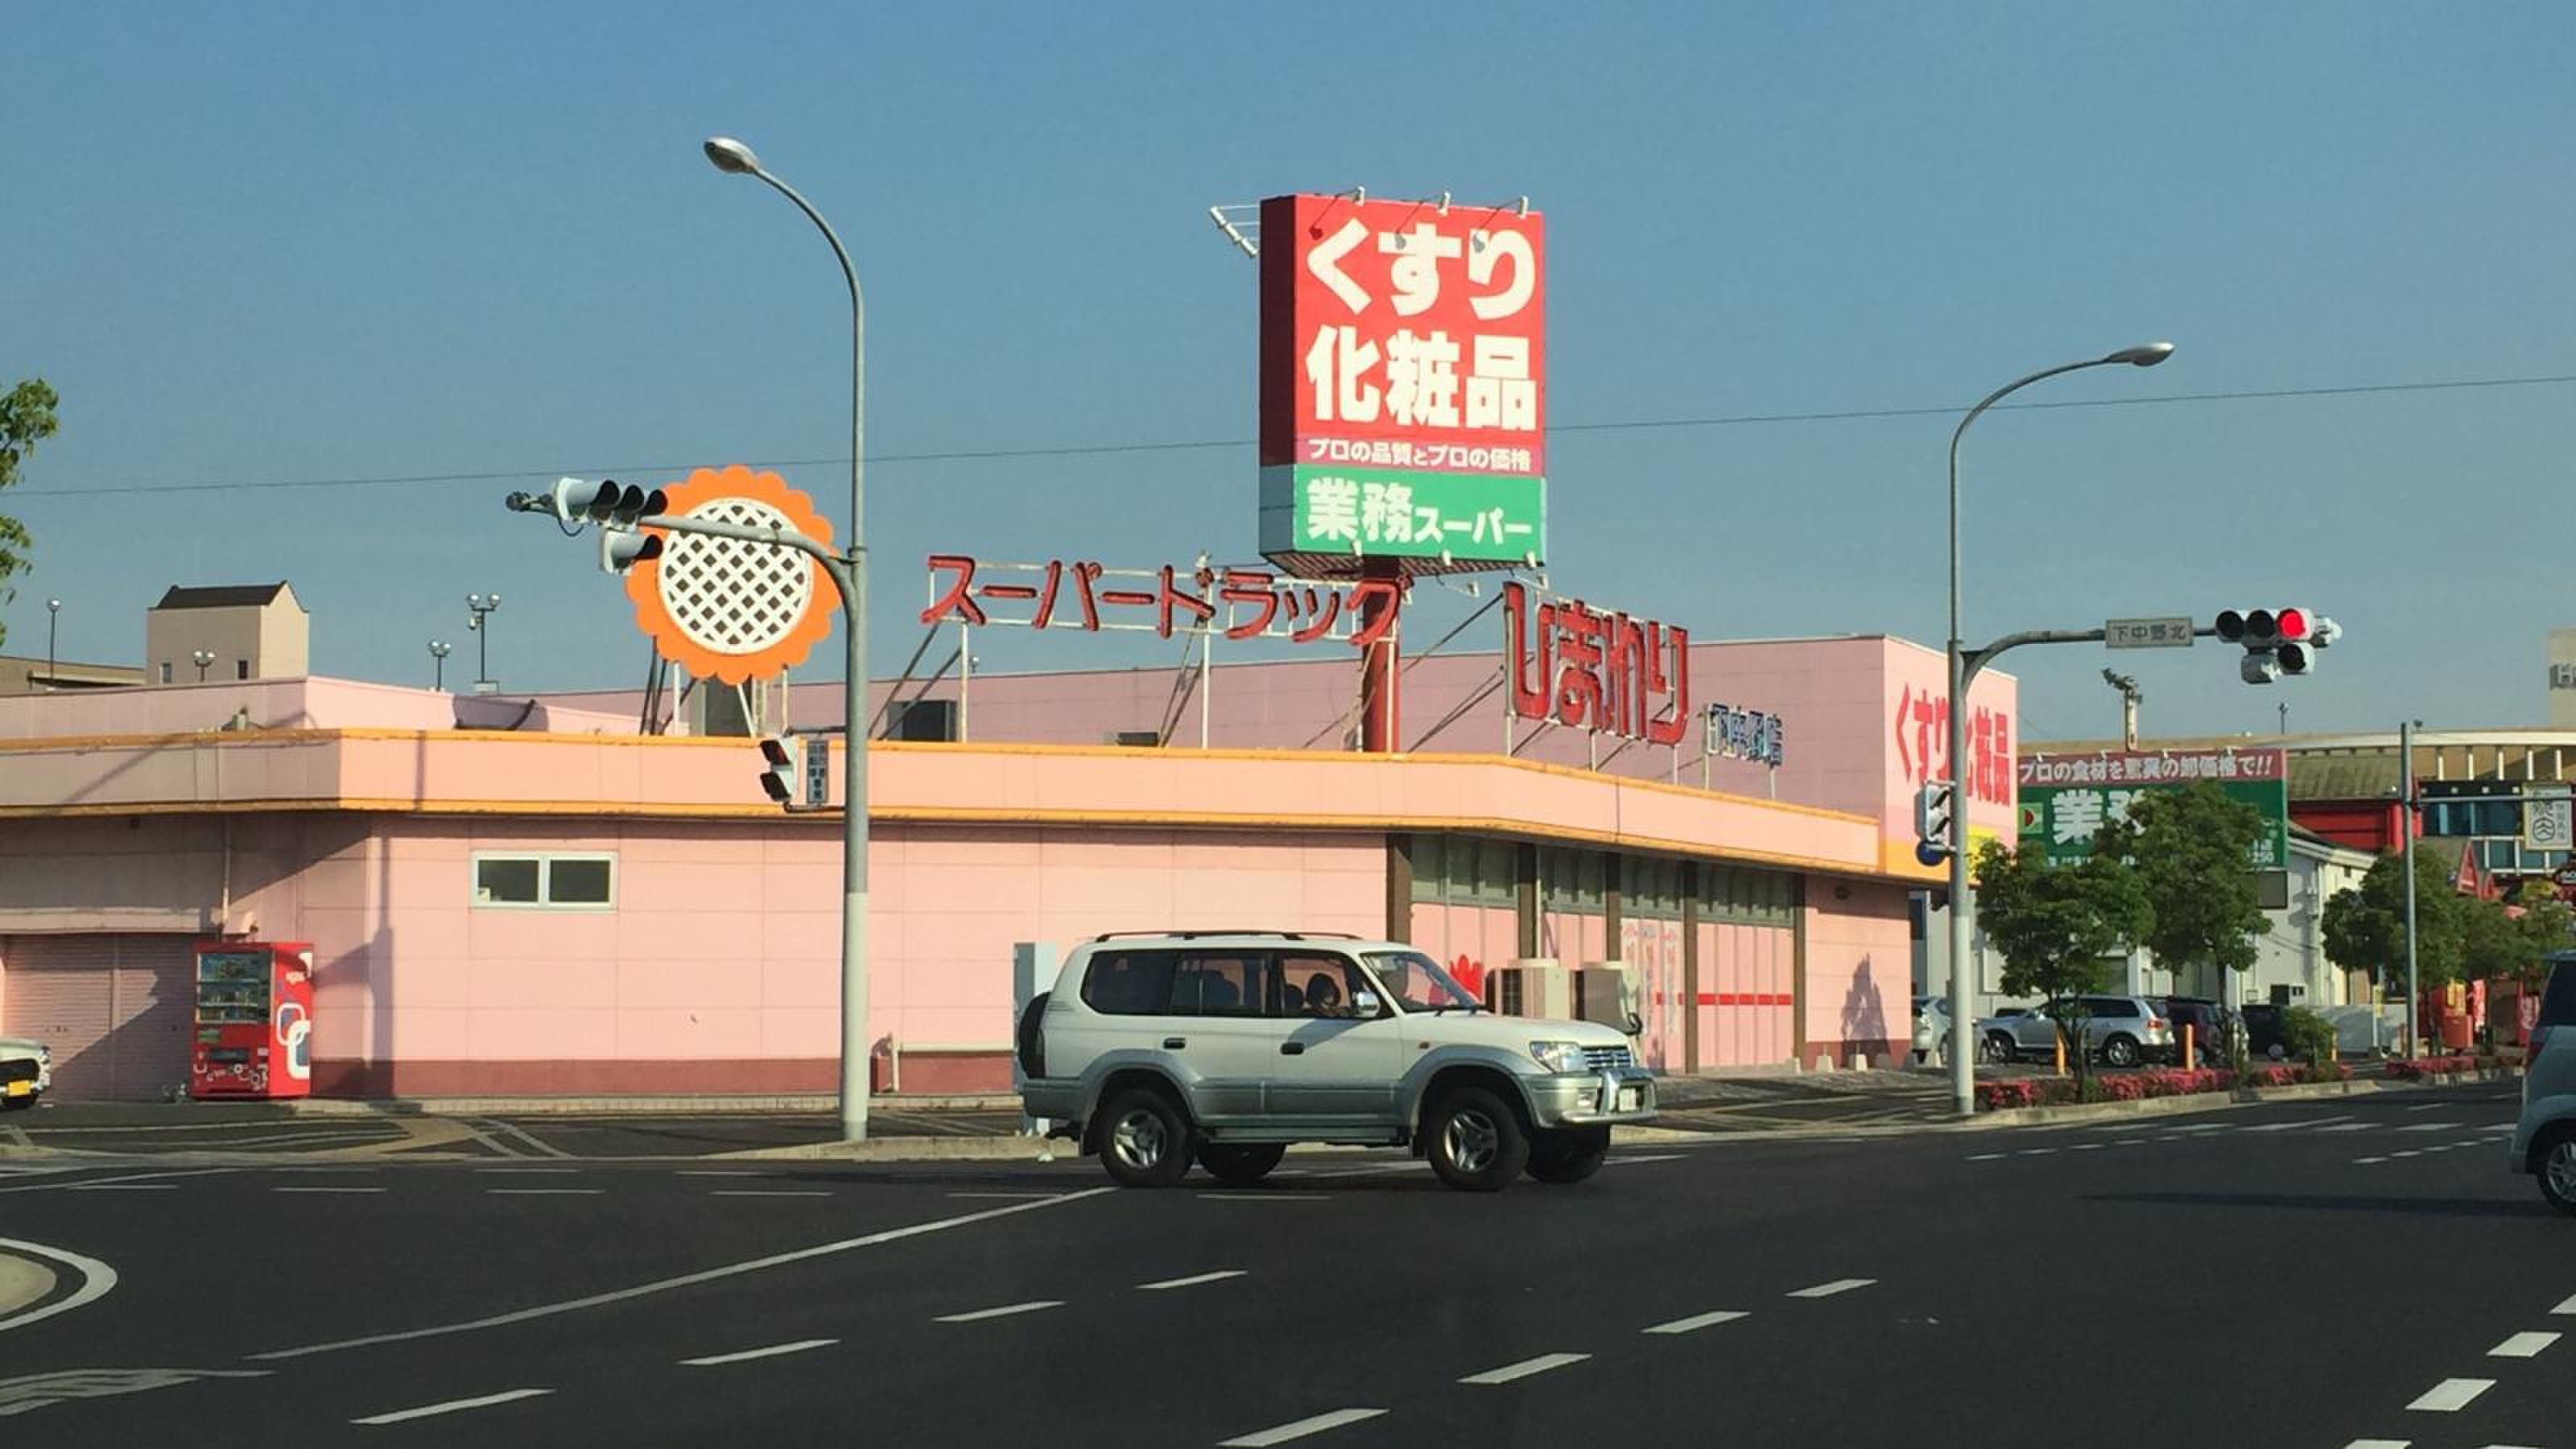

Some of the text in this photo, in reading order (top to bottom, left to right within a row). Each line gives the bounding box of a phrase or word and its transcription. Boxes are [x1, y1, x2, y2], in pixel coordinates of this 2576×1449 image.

[1307, 218, 1535, 320] くすり
[1305, 324, 1536, 430] 化粧品
[1308, 439, 1532, 471] プロの品質とプロの価格
[1306, 477, 1533, 545] 業務スーパー
